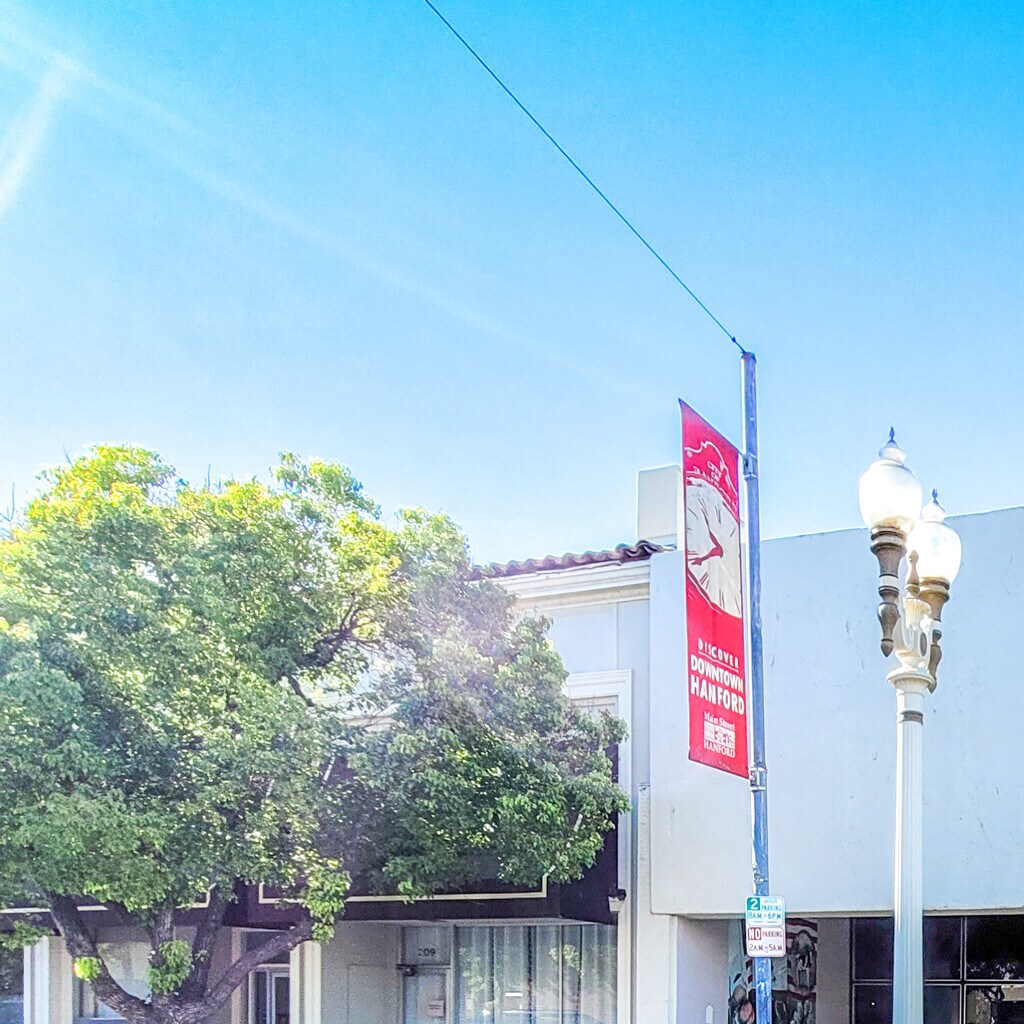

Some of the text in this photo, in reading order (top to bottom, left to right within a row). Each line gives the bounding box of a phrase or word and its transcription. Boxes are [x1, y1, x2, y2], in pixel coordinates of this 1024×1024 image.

[698, 638, 739, 669] DISCOVER
[691, 654, 744, 693] DOWNTOWN
[691, 674, 745, 715] HANFORD
[704, 740, 736, 758] HANFORD
[750, 898, 759, 910] 2
[762, 904, 782, 912] PARKING
[749, 928, 783, 940] NO PARKING
